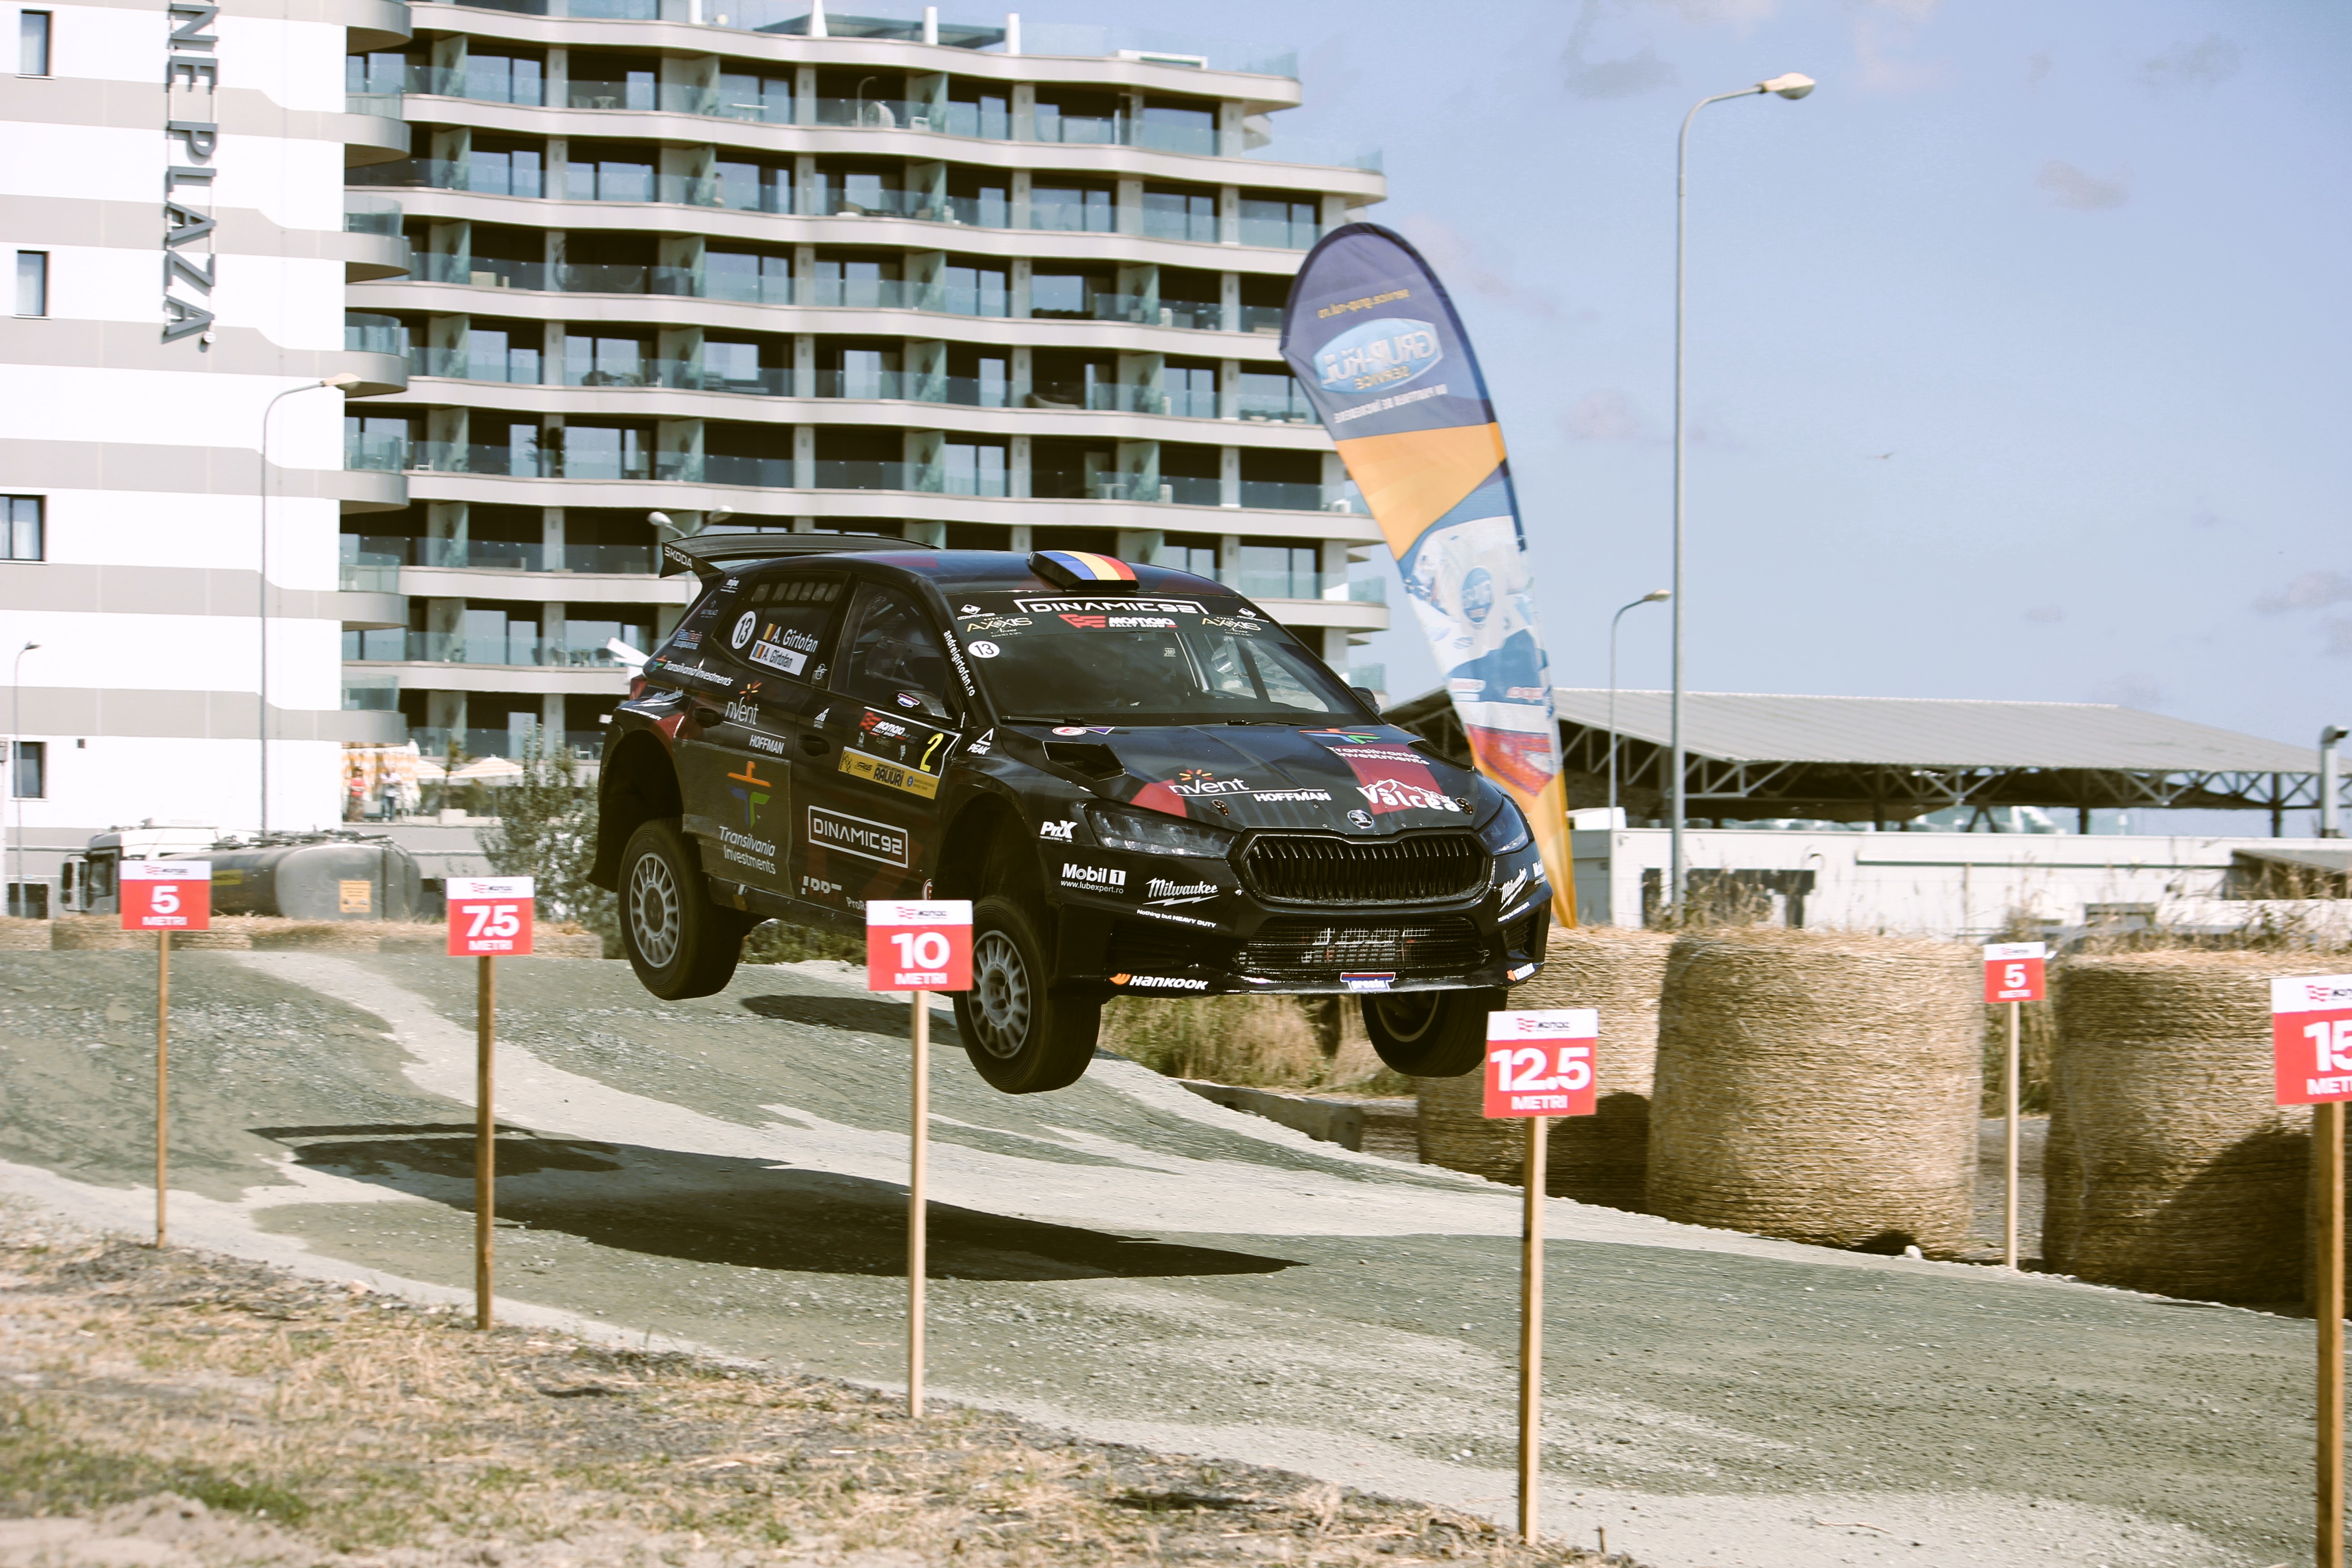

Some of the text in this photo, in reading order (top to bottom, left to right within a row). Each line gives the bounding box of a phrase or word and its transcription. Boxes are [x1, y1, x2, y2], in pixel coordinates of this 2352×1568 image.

[166, 0, 219, 335] NE PLAZA
[1029, 602, 1199, 614] DINAMIC92
[735, 617, 752, 644] 13
[770, 626, 782, 643] A.
[761, 647, 770, 661] A.
[974, 643, 995, 656] 13
[943, 630, 976, 696] andreigirtofan.ro
[749, 734, 784, 755] HOFFMAN
[920, 733, 944, 772] 2
[967, 743, 991, 755] PEAK
[1326, 746, 1422, 760] Transilvania
[1337, 752, 1430, 765] Investments
[874, 767, 904, 787] RALIURI
[1253, 792, 1332, 802] HOFFMAN
[719, 826, 776, 857] Transilvania
[813, 818, 902, 855] DINAMIC92
[724, 844, 776, 875] Investments
[1062, 863, 1107, 883] Mobil
[1061, 880, 1124, 894] www.lubexpert.ro
[1145, 877, 1219, 898] Milwaukee
[151, 885, 181, 914] 5
[846, 897, 867, 911] ProR
[142, 916, 188, 926] METRI
[462, 905, 520, 937] 7.5
[1137, 909, 1161, 919] Nothing
[1172, 915, 1196, 924] HEAVY
[1196, 920, 1217, 928] DUTY
[468, 940, 513, 951] METRI
[891, 931, 951, 970] 10
[894, 972, 948, 985] METRI
[2003, 963, 2027, 989] 5
[1490, 1046, 1592, 1092] 12.5
[1511, 1095, 1568, 1110] METRI
